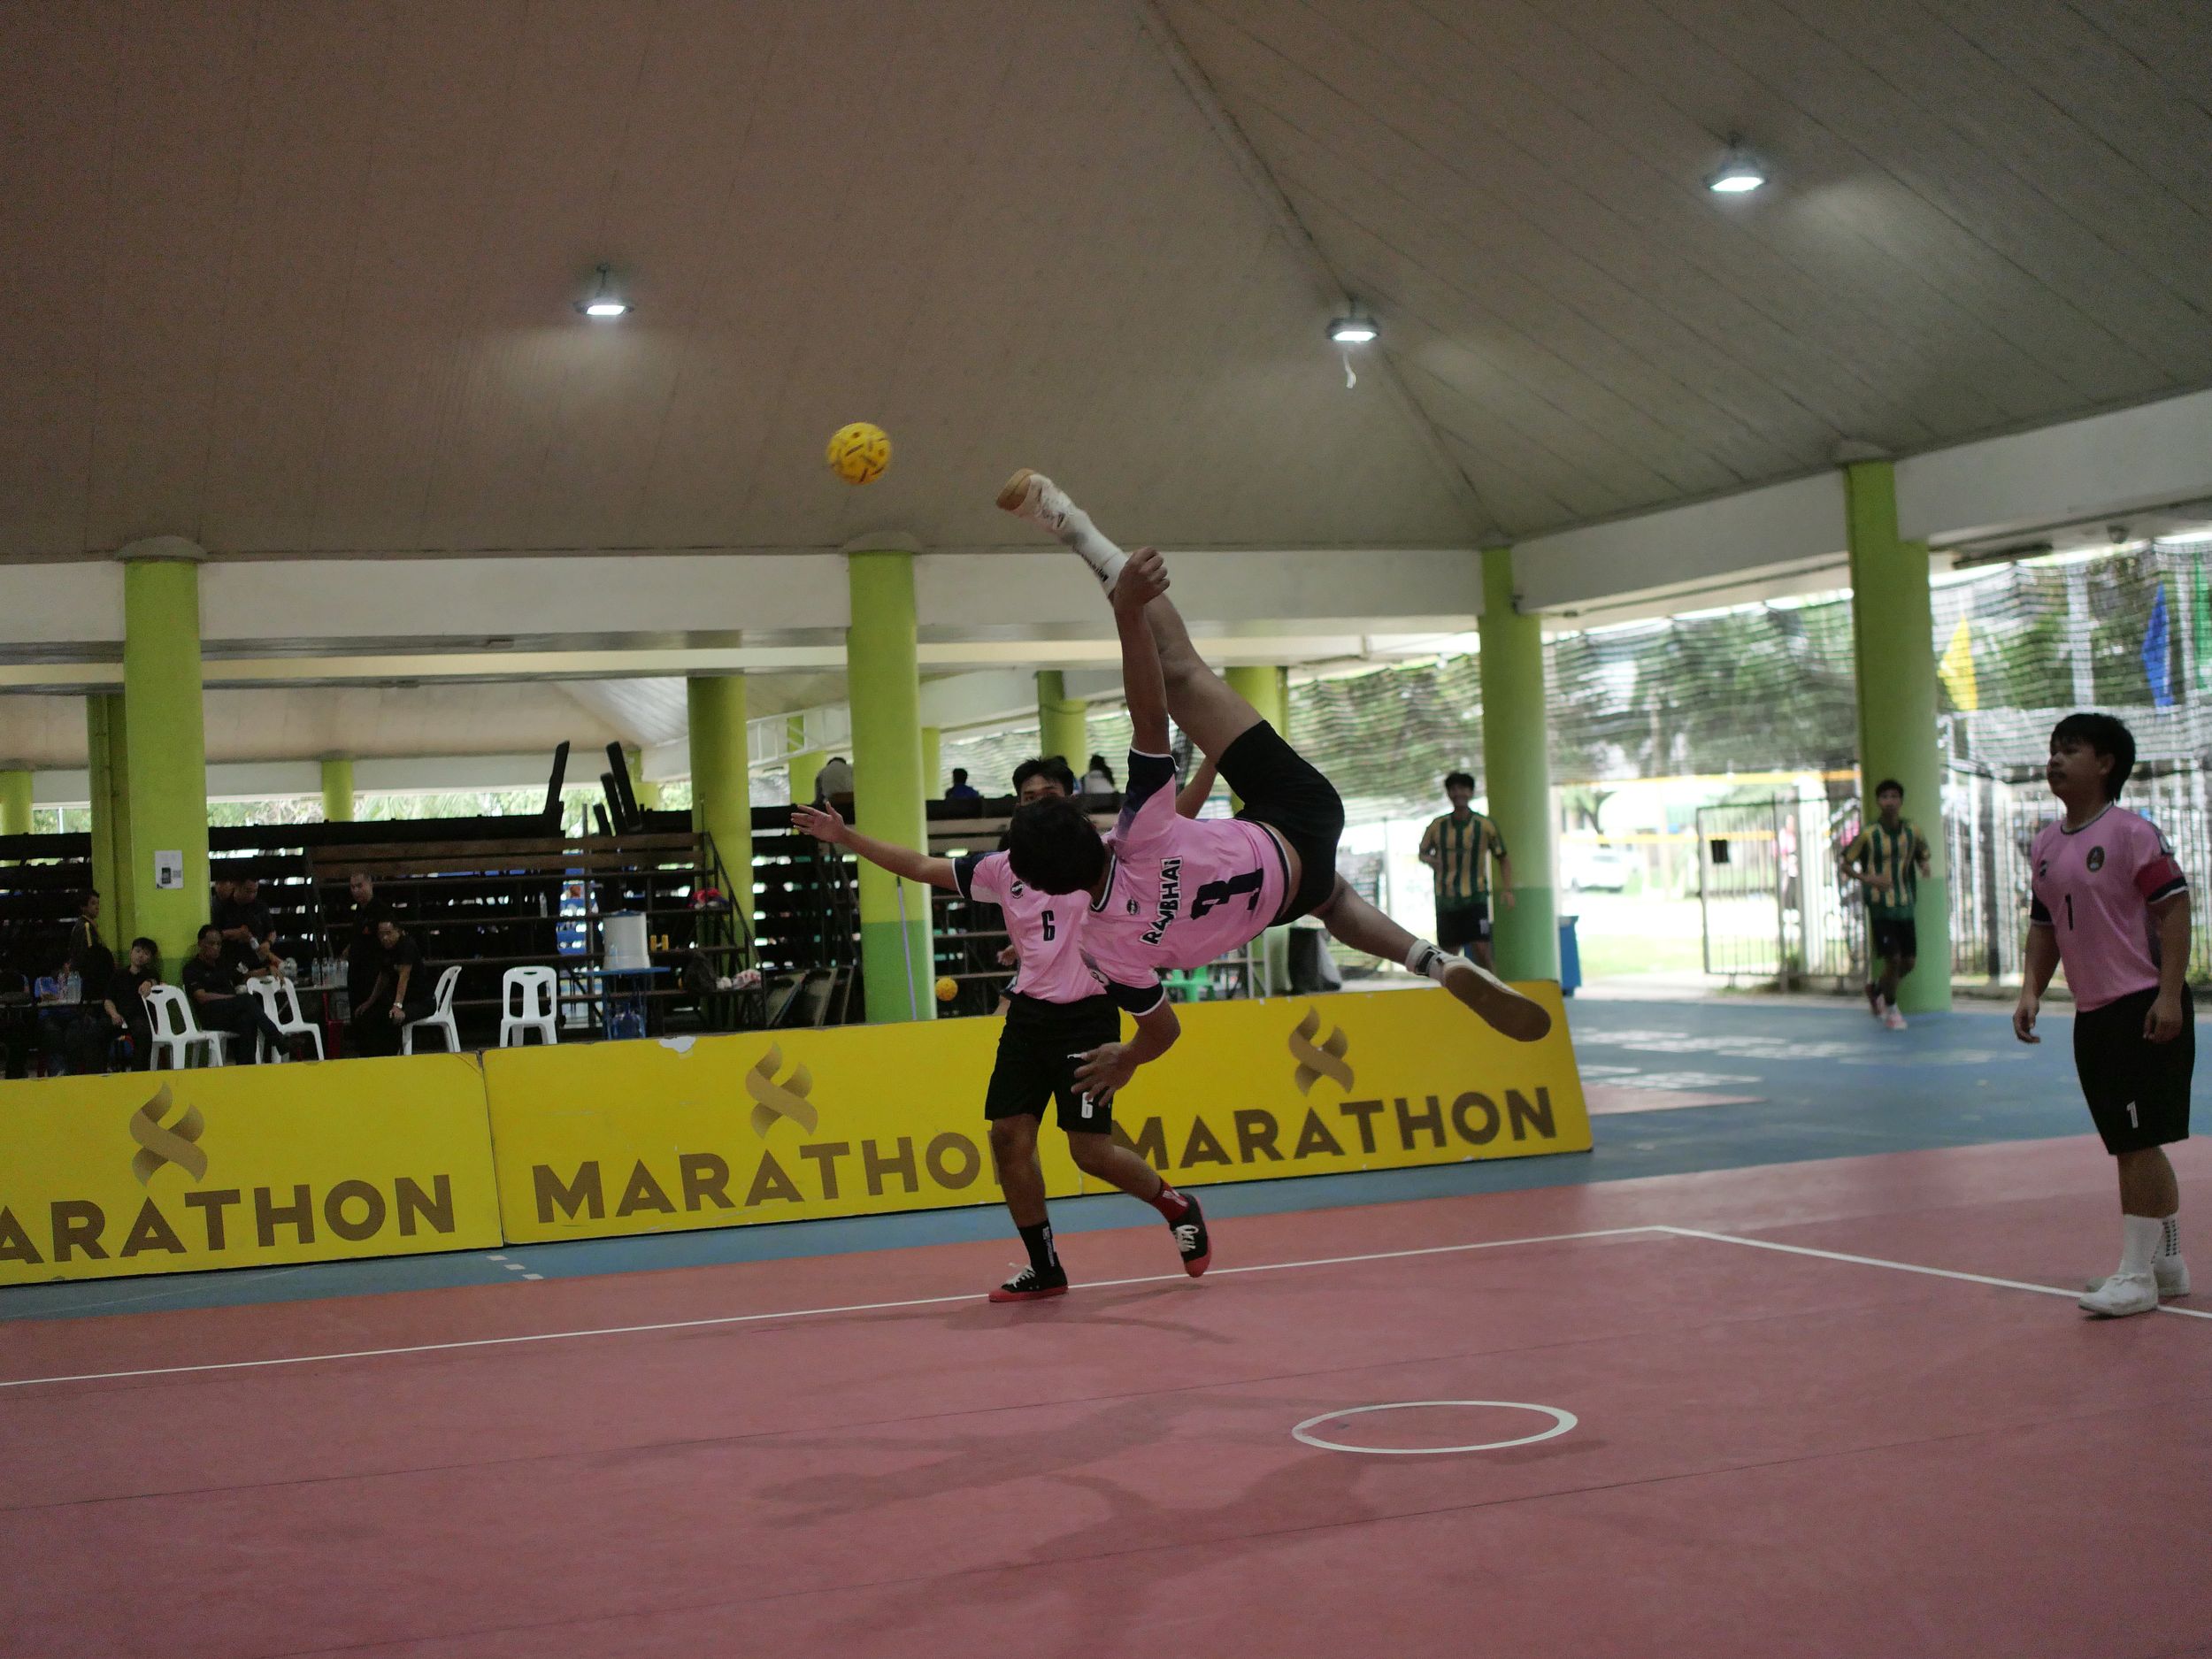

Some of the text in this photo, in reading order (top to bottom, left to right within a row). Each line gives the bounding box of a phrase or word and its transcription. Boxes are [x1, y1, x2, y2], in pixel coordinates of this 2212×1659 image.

[1041, 910, 1056, 941] 6
[2064, 893, 2074, 930] 1
[1081, 1091, 1094, 1119] 6
[2126, 1100, 2139, 1129] 1
[1111, 1086, 1557, 1171] MARATHON
[532, 1130, 1002, 1225] MARATHO
